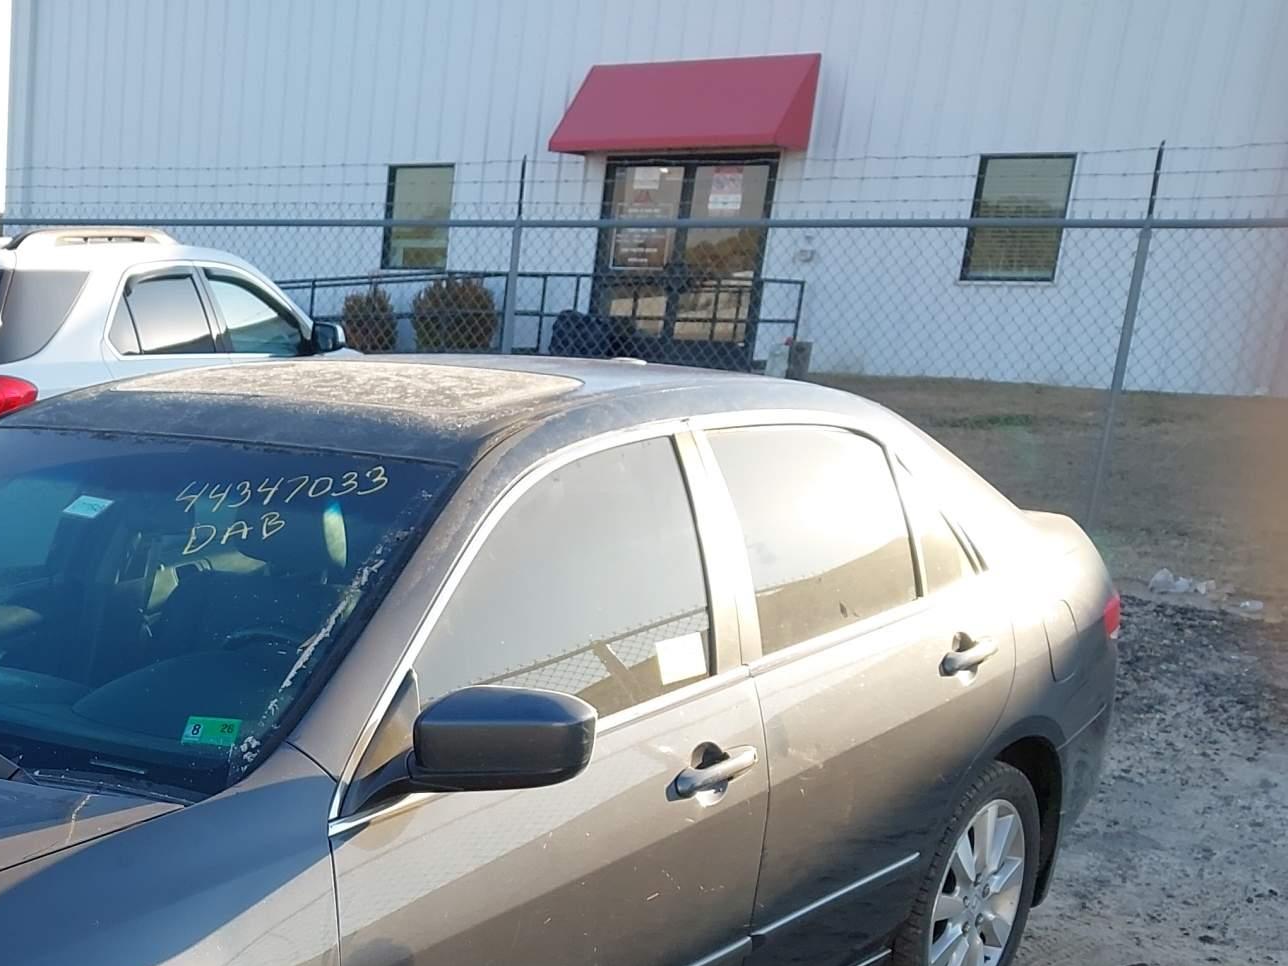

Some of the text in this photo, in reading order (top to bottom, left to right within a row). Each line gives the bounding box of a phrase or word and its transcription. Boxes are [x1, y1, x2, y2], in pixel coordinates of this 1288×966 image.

[175, 465, 389, 512] 44347033
[182, 511, 286, 555] DAB
[192, 724, 201, 735] 8
